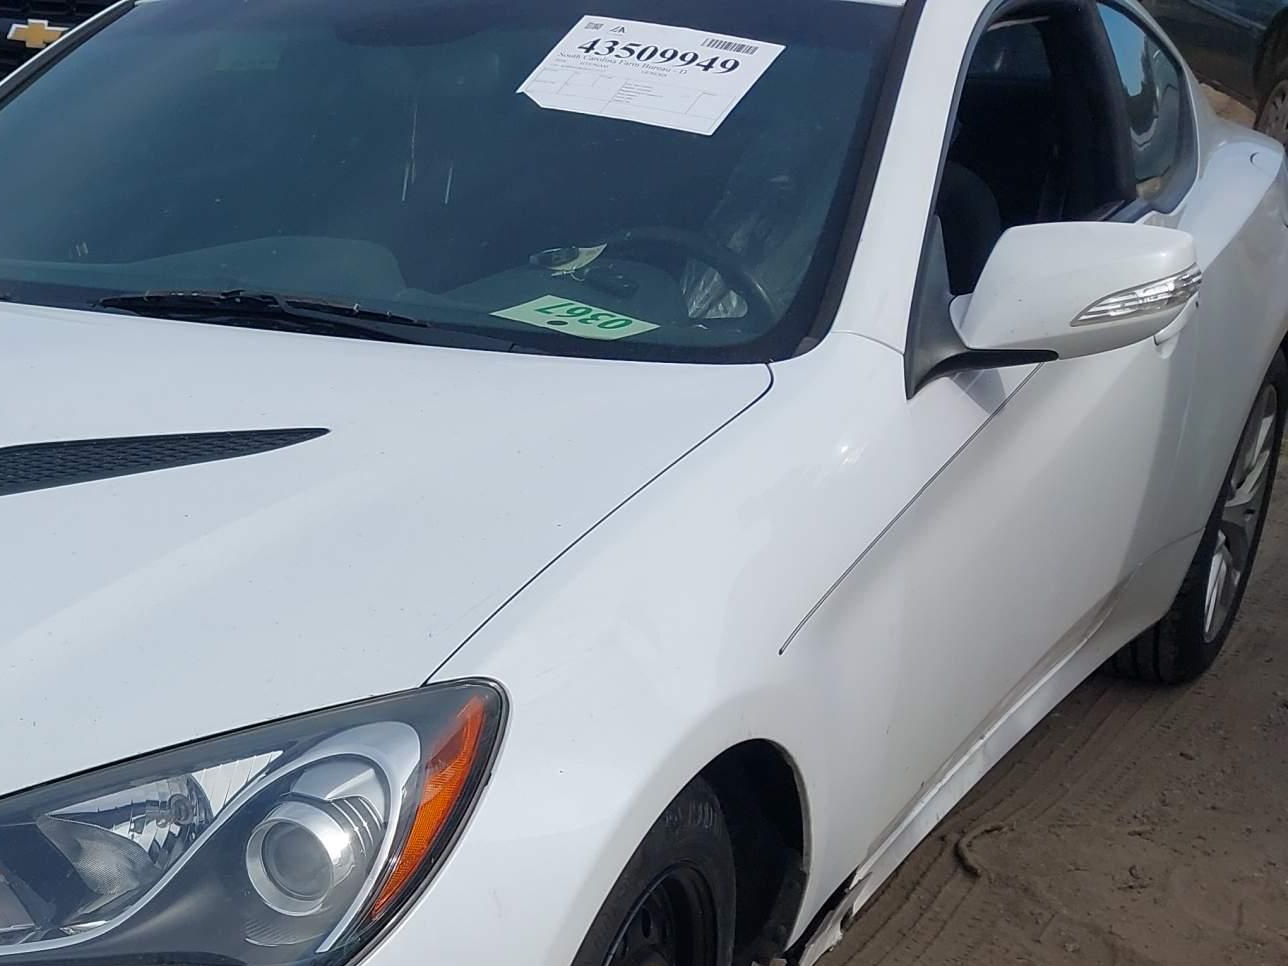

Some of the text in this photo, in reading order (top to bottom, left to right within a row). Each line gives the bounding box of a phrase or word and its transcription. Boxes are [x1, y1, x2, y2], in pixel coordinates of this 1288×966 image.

[577, 38, 740, 74] 43509949
[583, 54, 617, 64] Carolina
[535, 303, 632, 329] 0367
